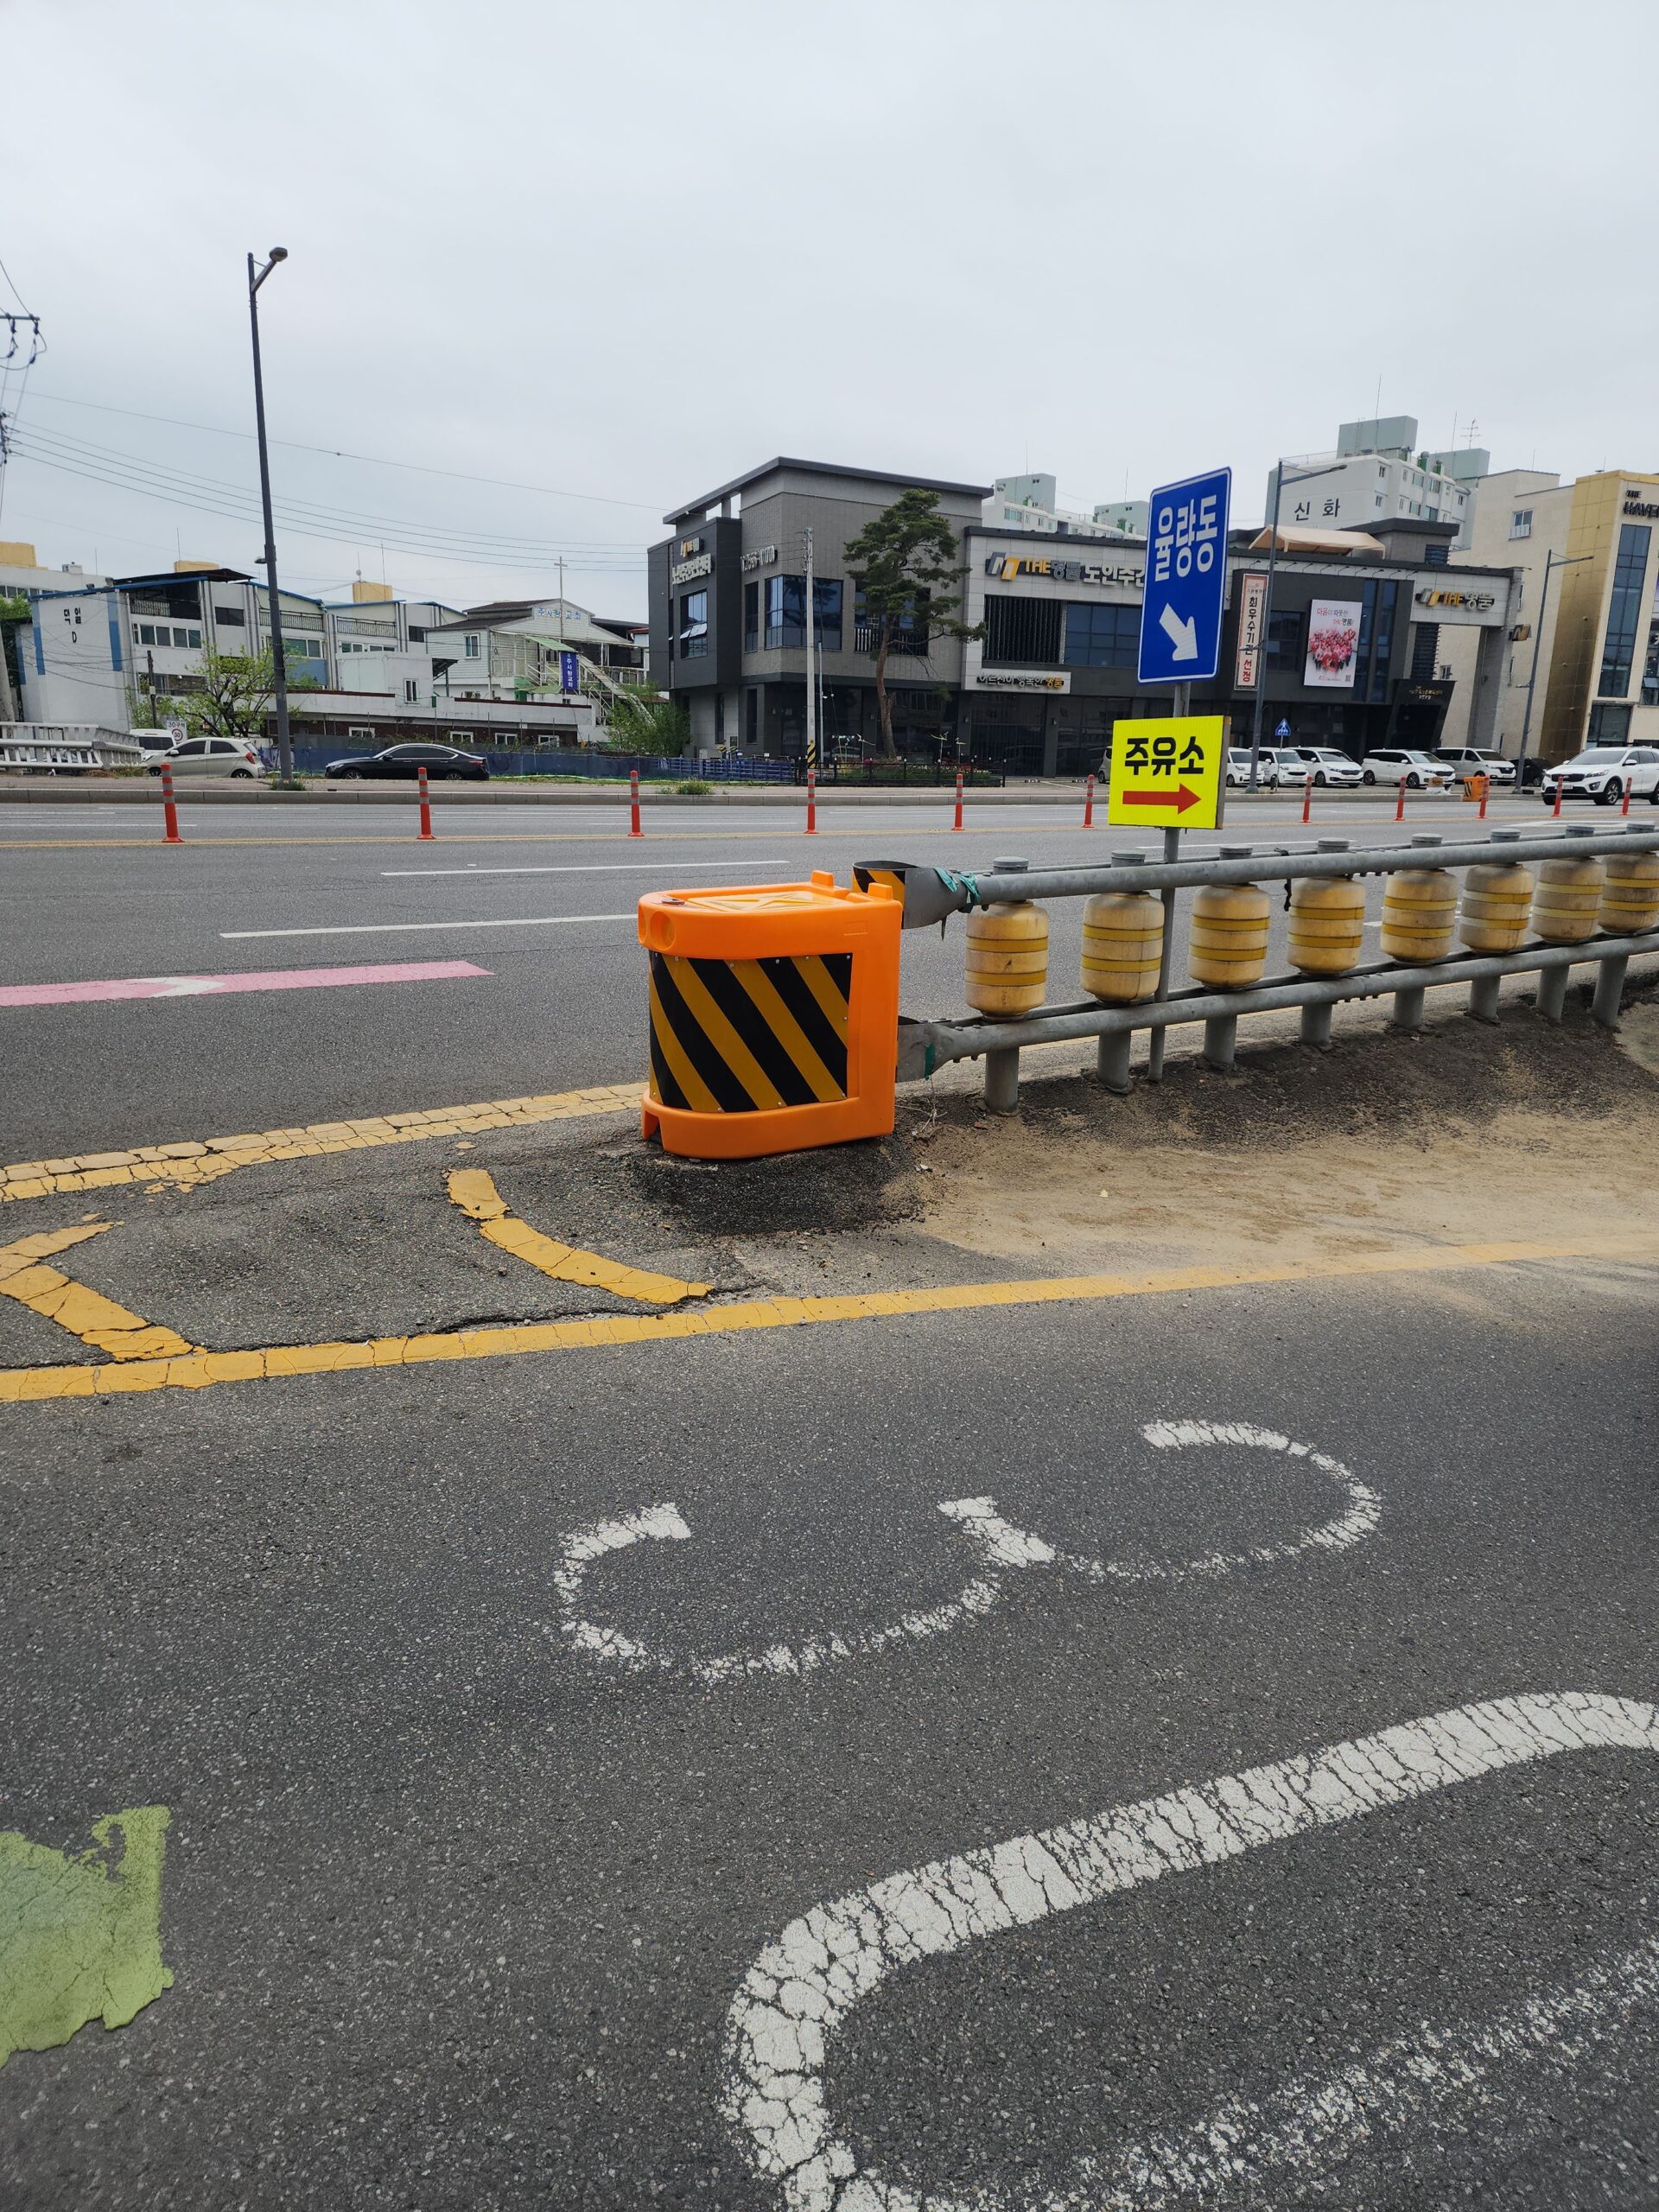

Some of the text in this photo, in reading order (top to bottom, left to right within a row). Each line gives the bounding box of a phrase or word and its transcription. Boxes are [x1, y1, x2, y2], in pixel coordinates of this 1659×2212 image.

[1625, 490, 1642, 499] THE
[1154, 494, 1218, 582] 율량동
[1124, 736, 1205, 776] 주유소
